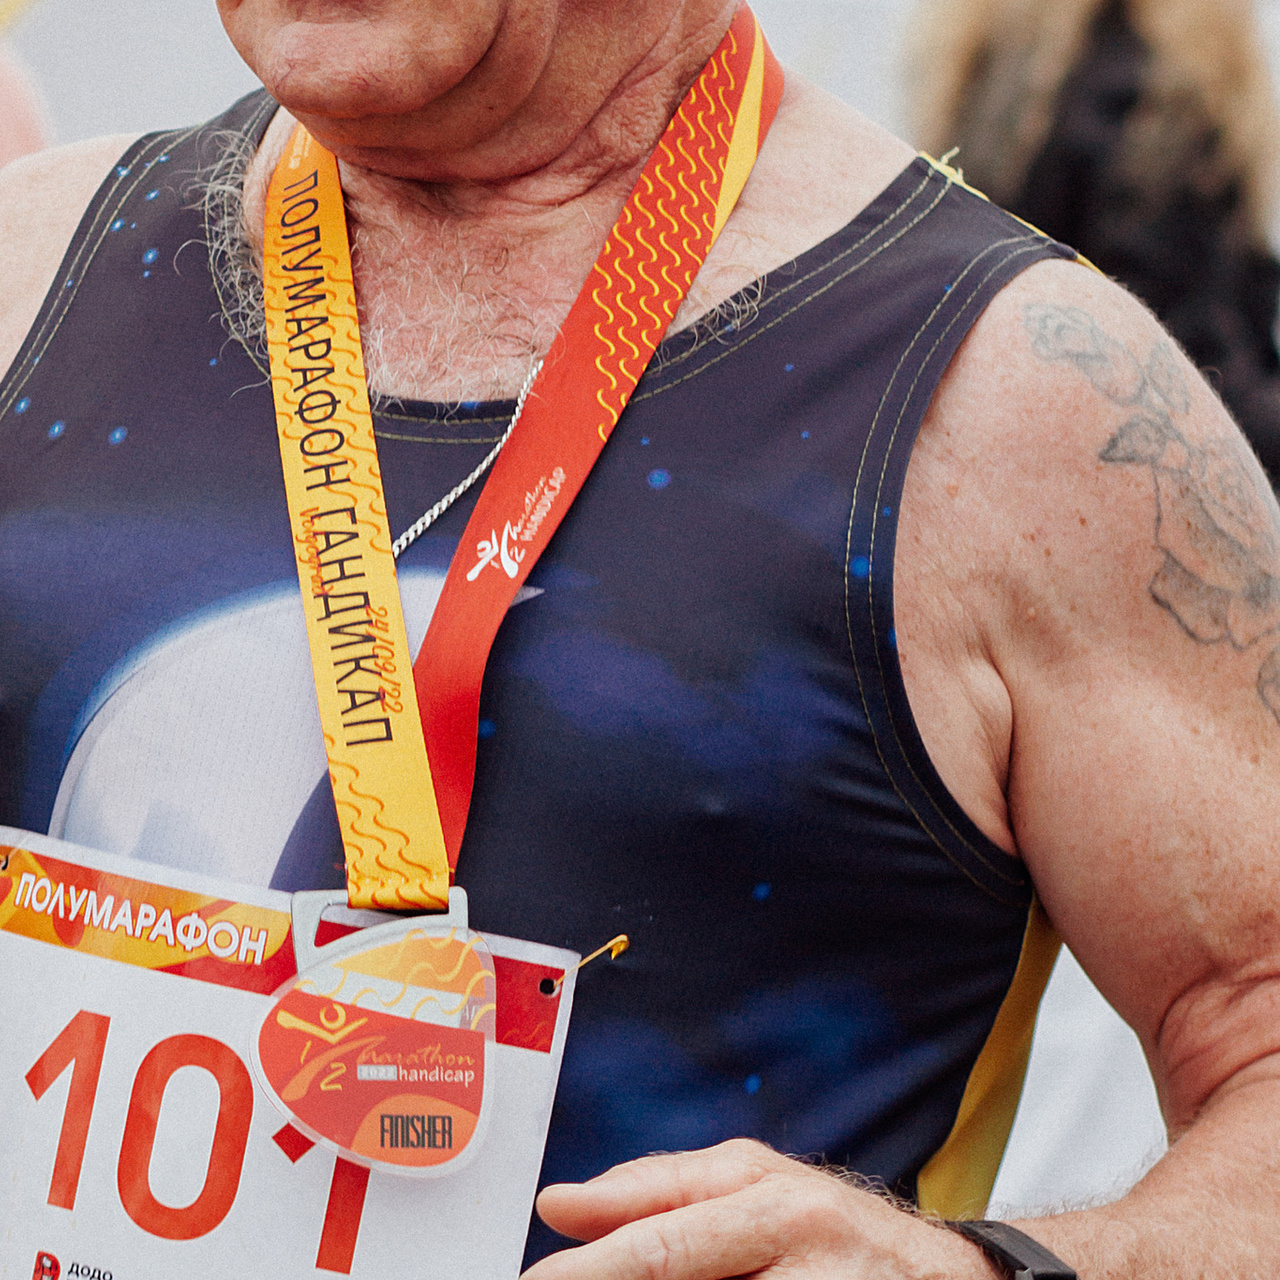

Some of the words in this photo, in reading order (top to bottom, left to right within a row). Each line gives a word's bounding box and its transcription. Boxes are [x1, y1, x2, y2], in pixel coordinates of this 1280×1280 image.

[280, 169, 351, 491] ПОЛУМАРАФОН
[310, 507, 393, 747] ГАНДИКАП
[15, 872, 268, 965] ПОЛУМАРАФОН
[399, 1065, 475, 1088] handicap
[380, 1114, 453, 1149] FINISHER
